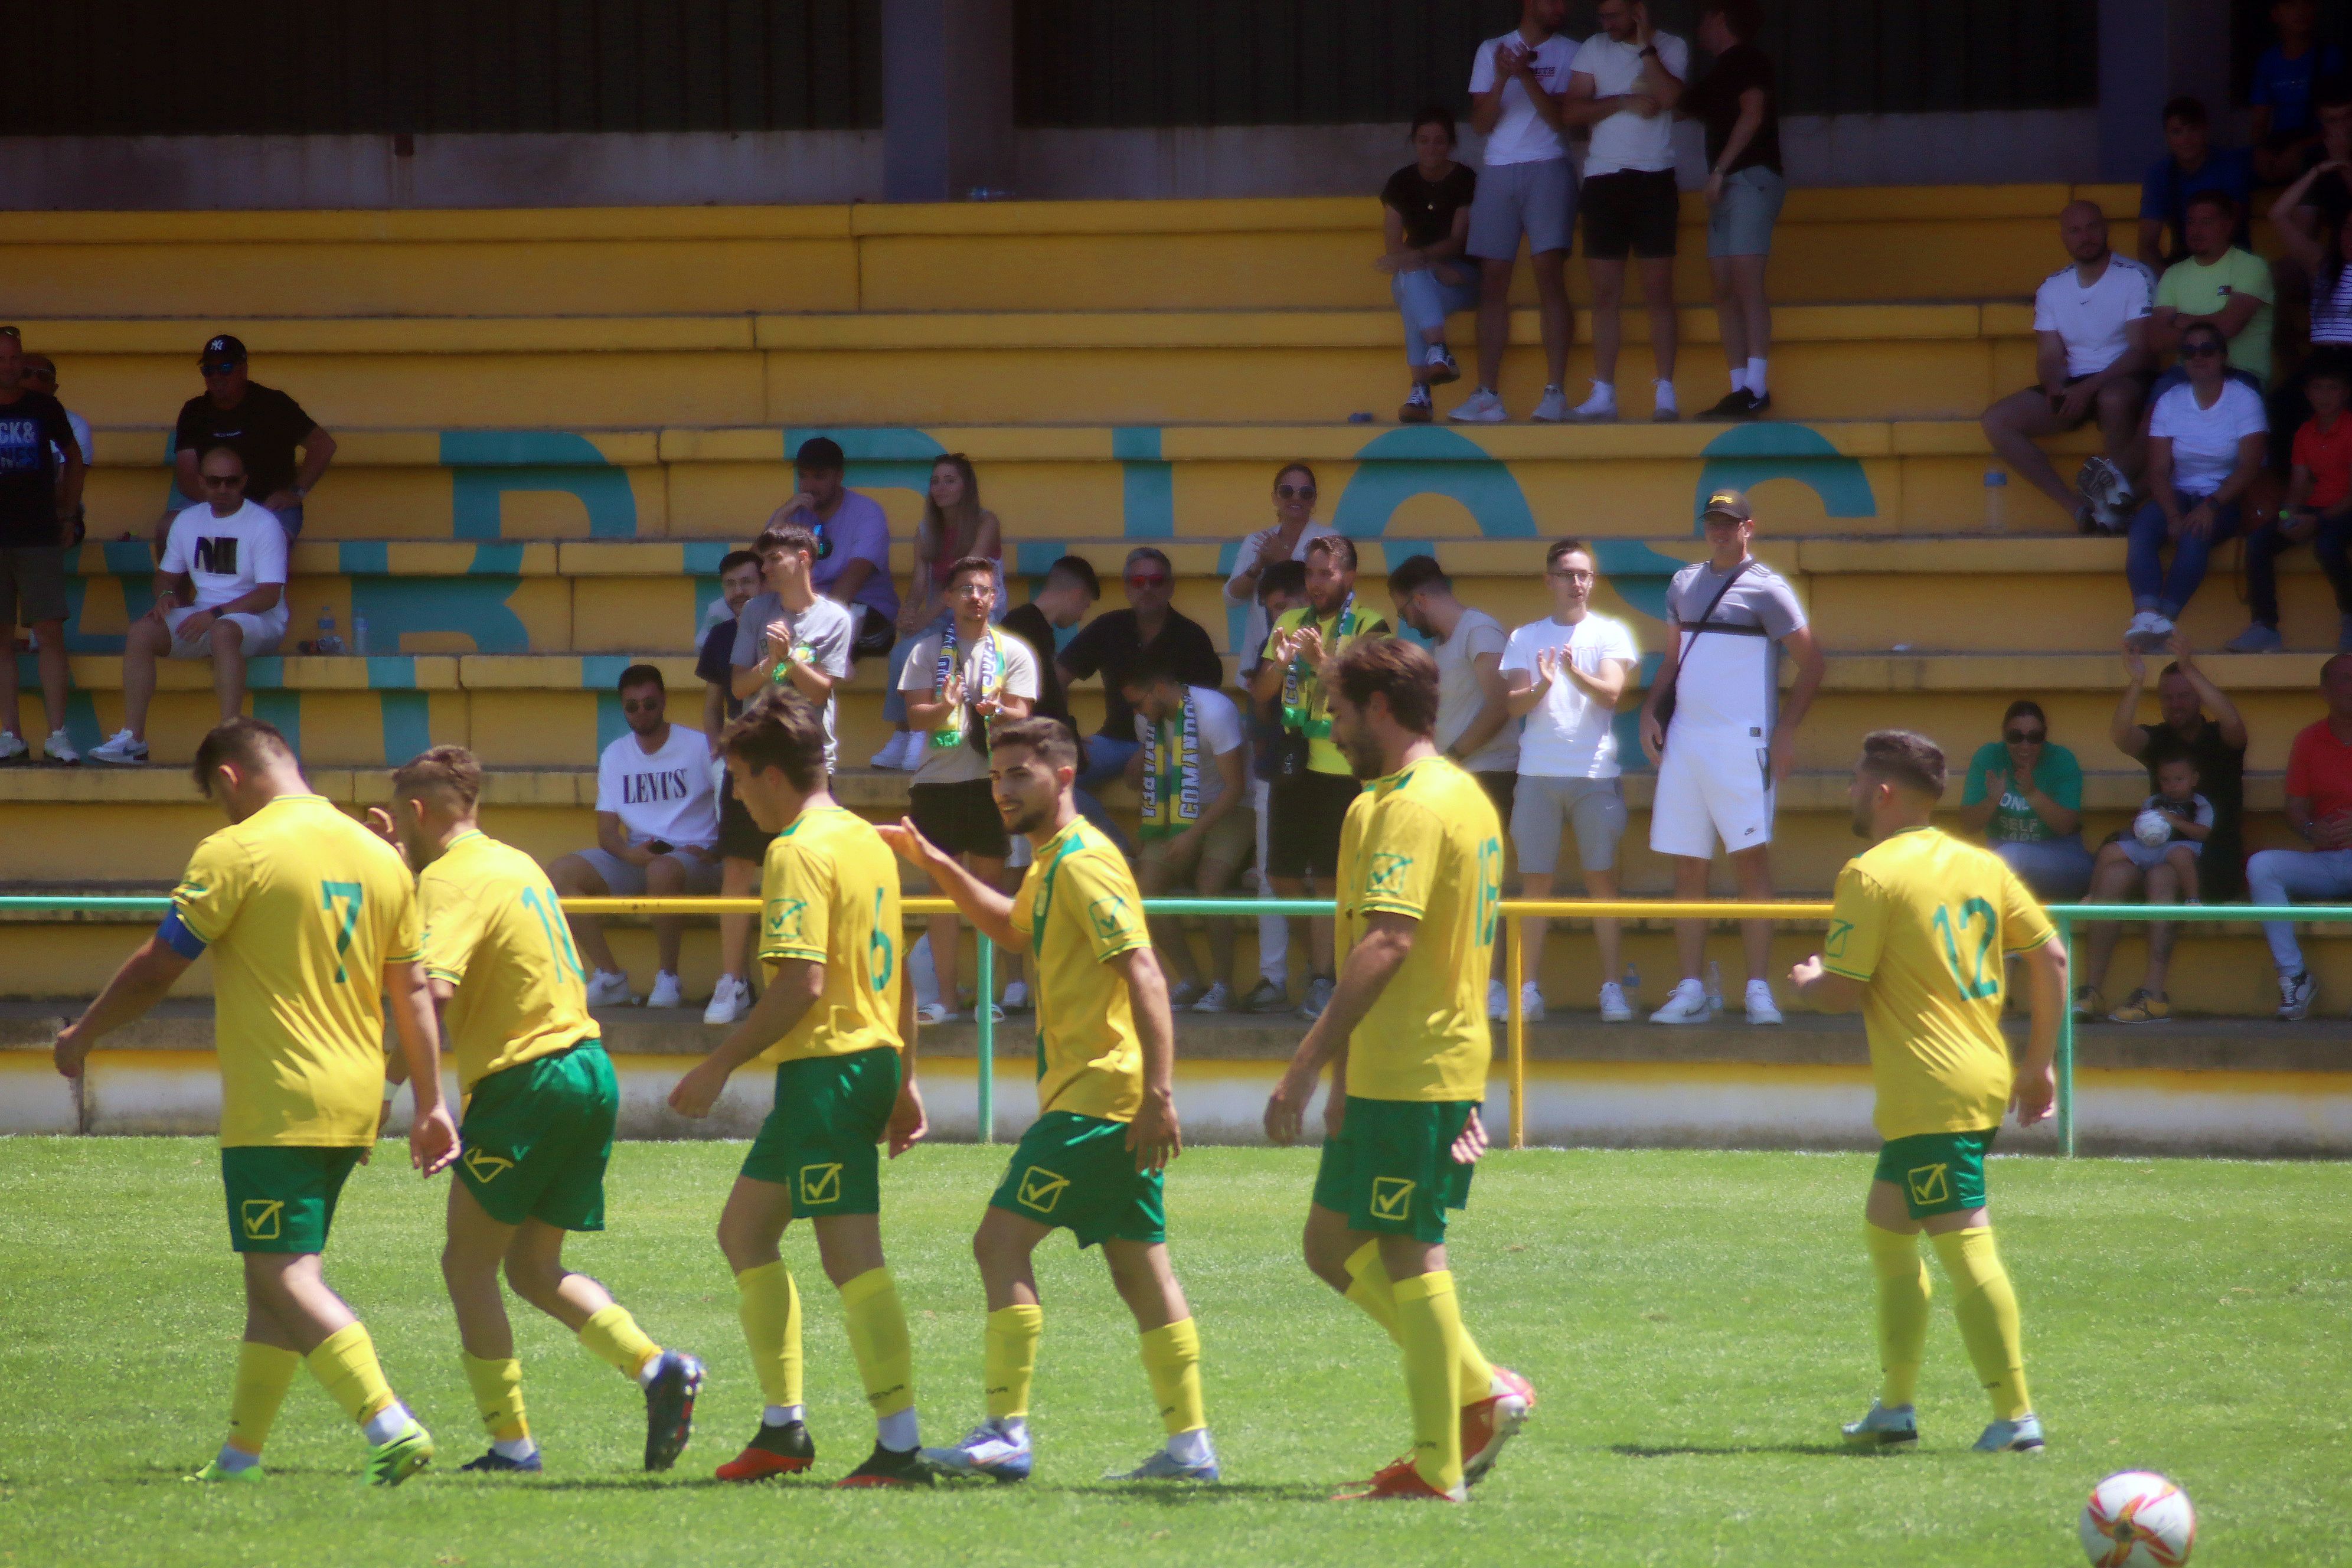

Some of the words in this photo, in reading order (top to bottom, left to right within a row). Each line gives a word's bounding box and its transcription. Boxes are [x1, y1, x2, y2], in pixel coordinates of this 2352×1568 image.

[622, 769, 687, 804] LEVI'S
[322, 880, 362, 983] 7
[869, 887, 893, 992] 6
[1932, 896, 1999, 1002] 12
